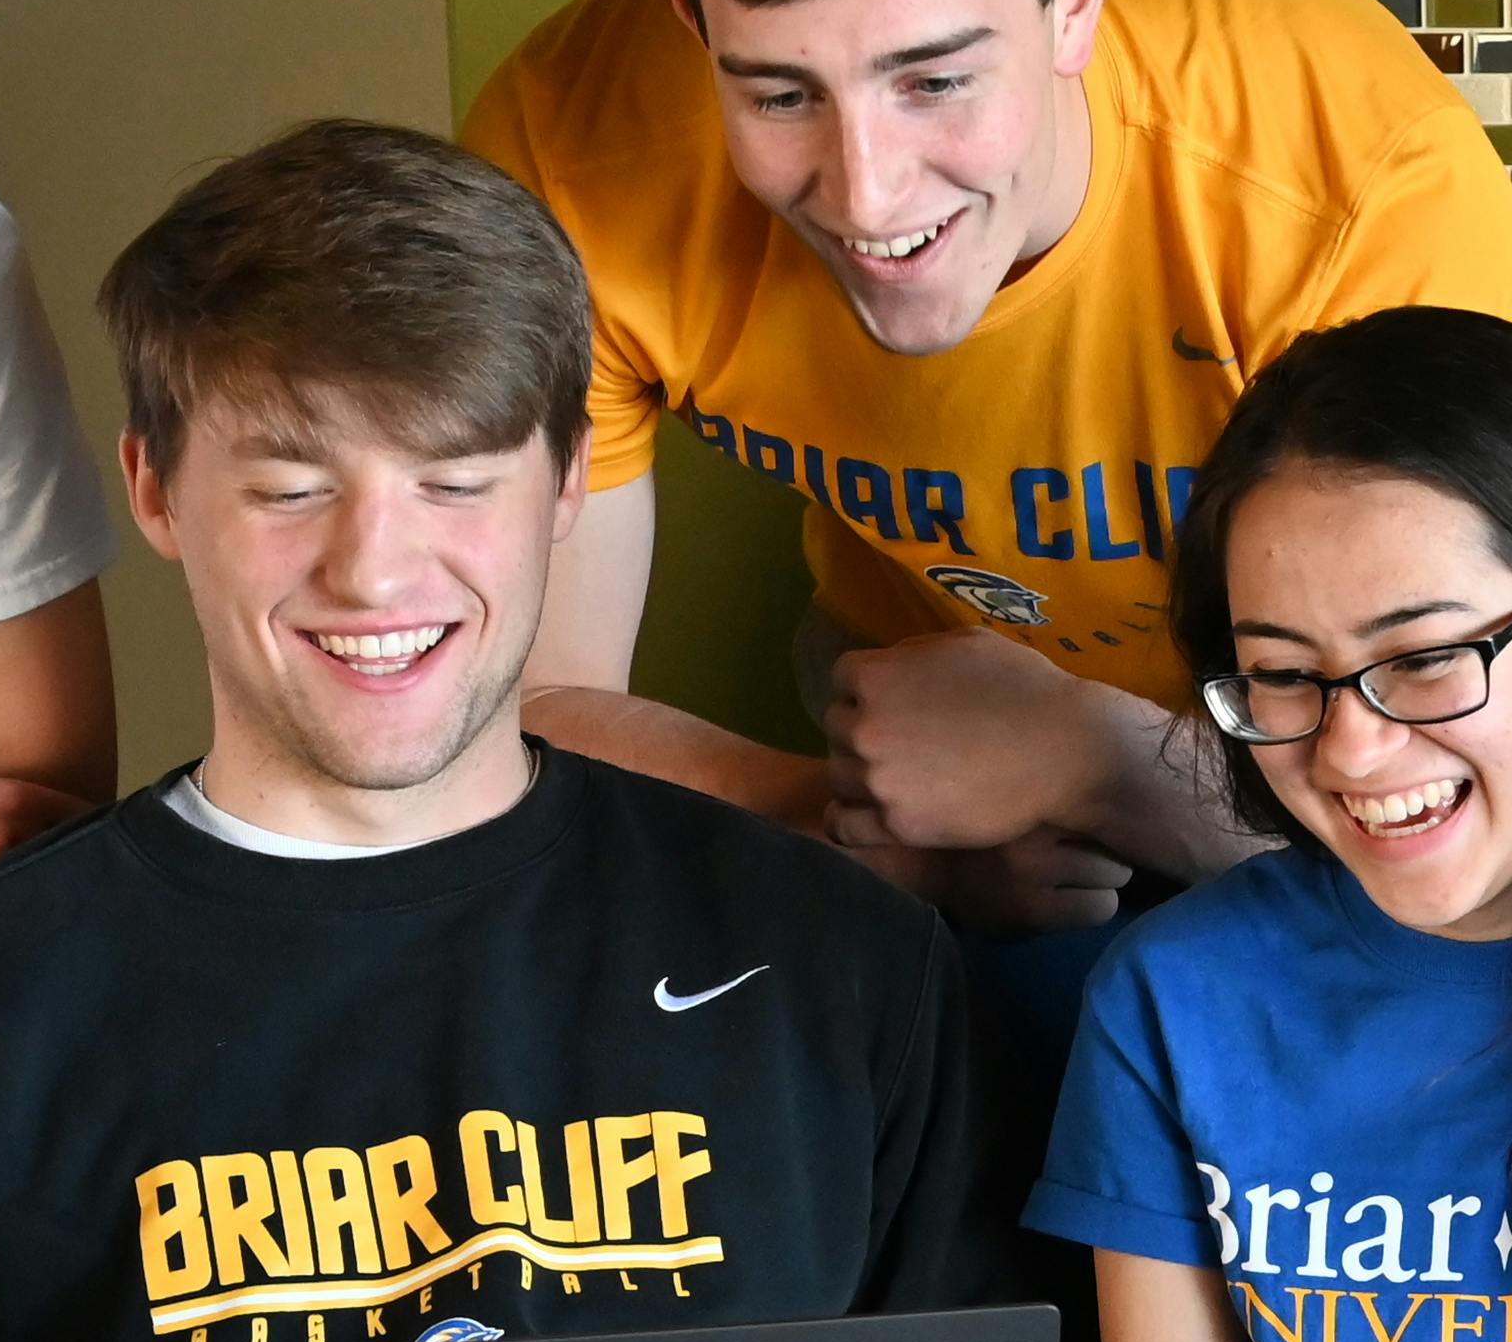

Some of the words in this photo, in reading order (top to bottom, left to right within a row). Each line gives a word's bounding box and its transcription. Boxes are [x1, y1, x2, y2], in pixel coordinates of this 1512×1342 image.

[1010, 459, 1200, 561] CLI
[135, 1134, 453, 1302] BRIAR
[458, 1109, 713, 1243] CLIFF
